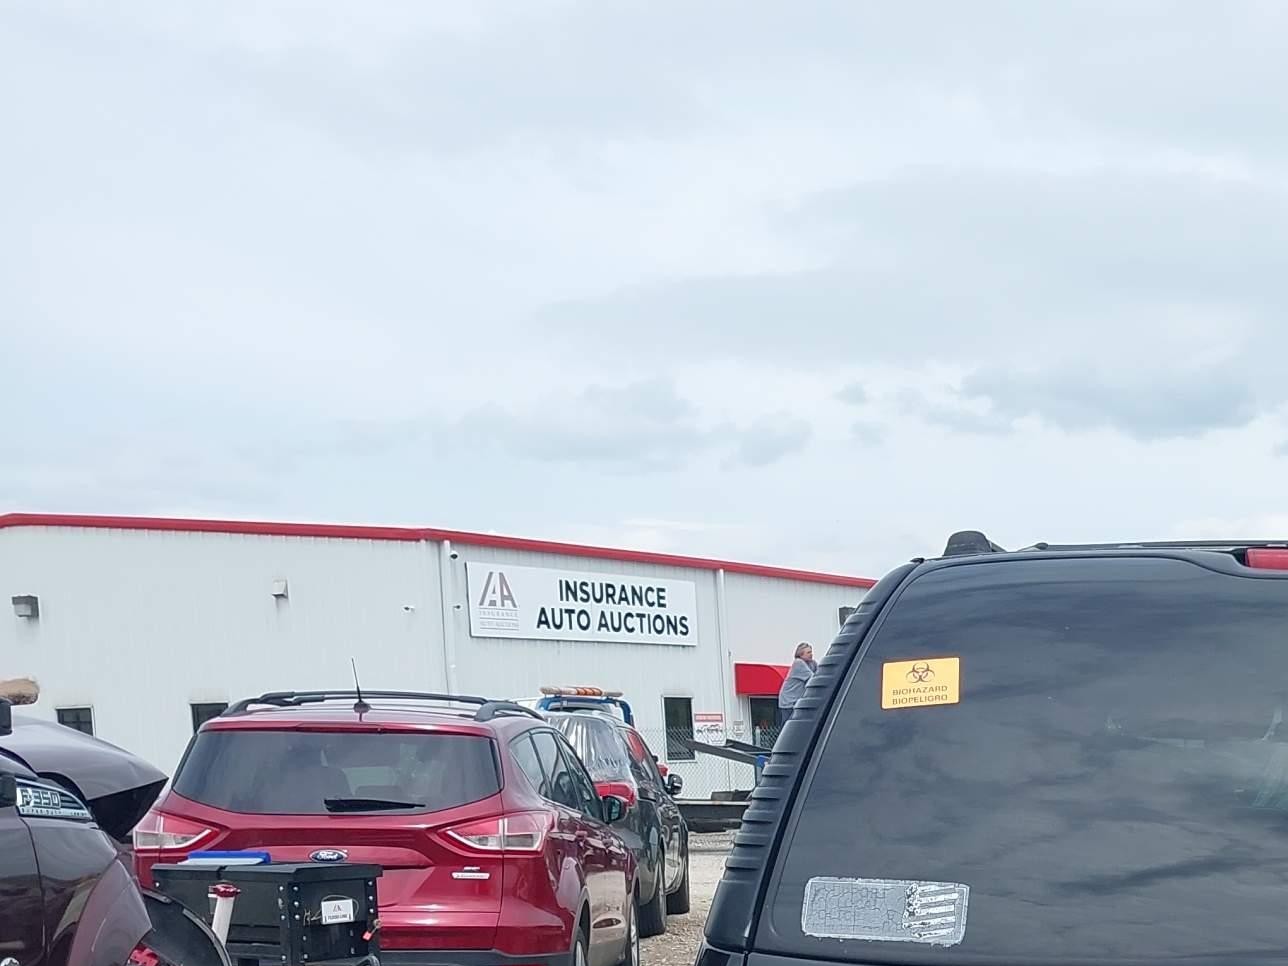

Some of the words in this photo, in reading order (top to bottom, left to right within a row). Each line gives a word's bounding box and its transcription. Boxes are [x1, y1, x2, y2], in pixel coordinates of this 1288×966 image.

[559, 579, 667, 608] INSURANCE
[537, 607, 591, 631] AUTO
[597, 611, 690, 636] AUCTIONS
[892, 685, 948, 696] BIOHAZARD
[892, 694, 948, 705] BIOPELIGRO
